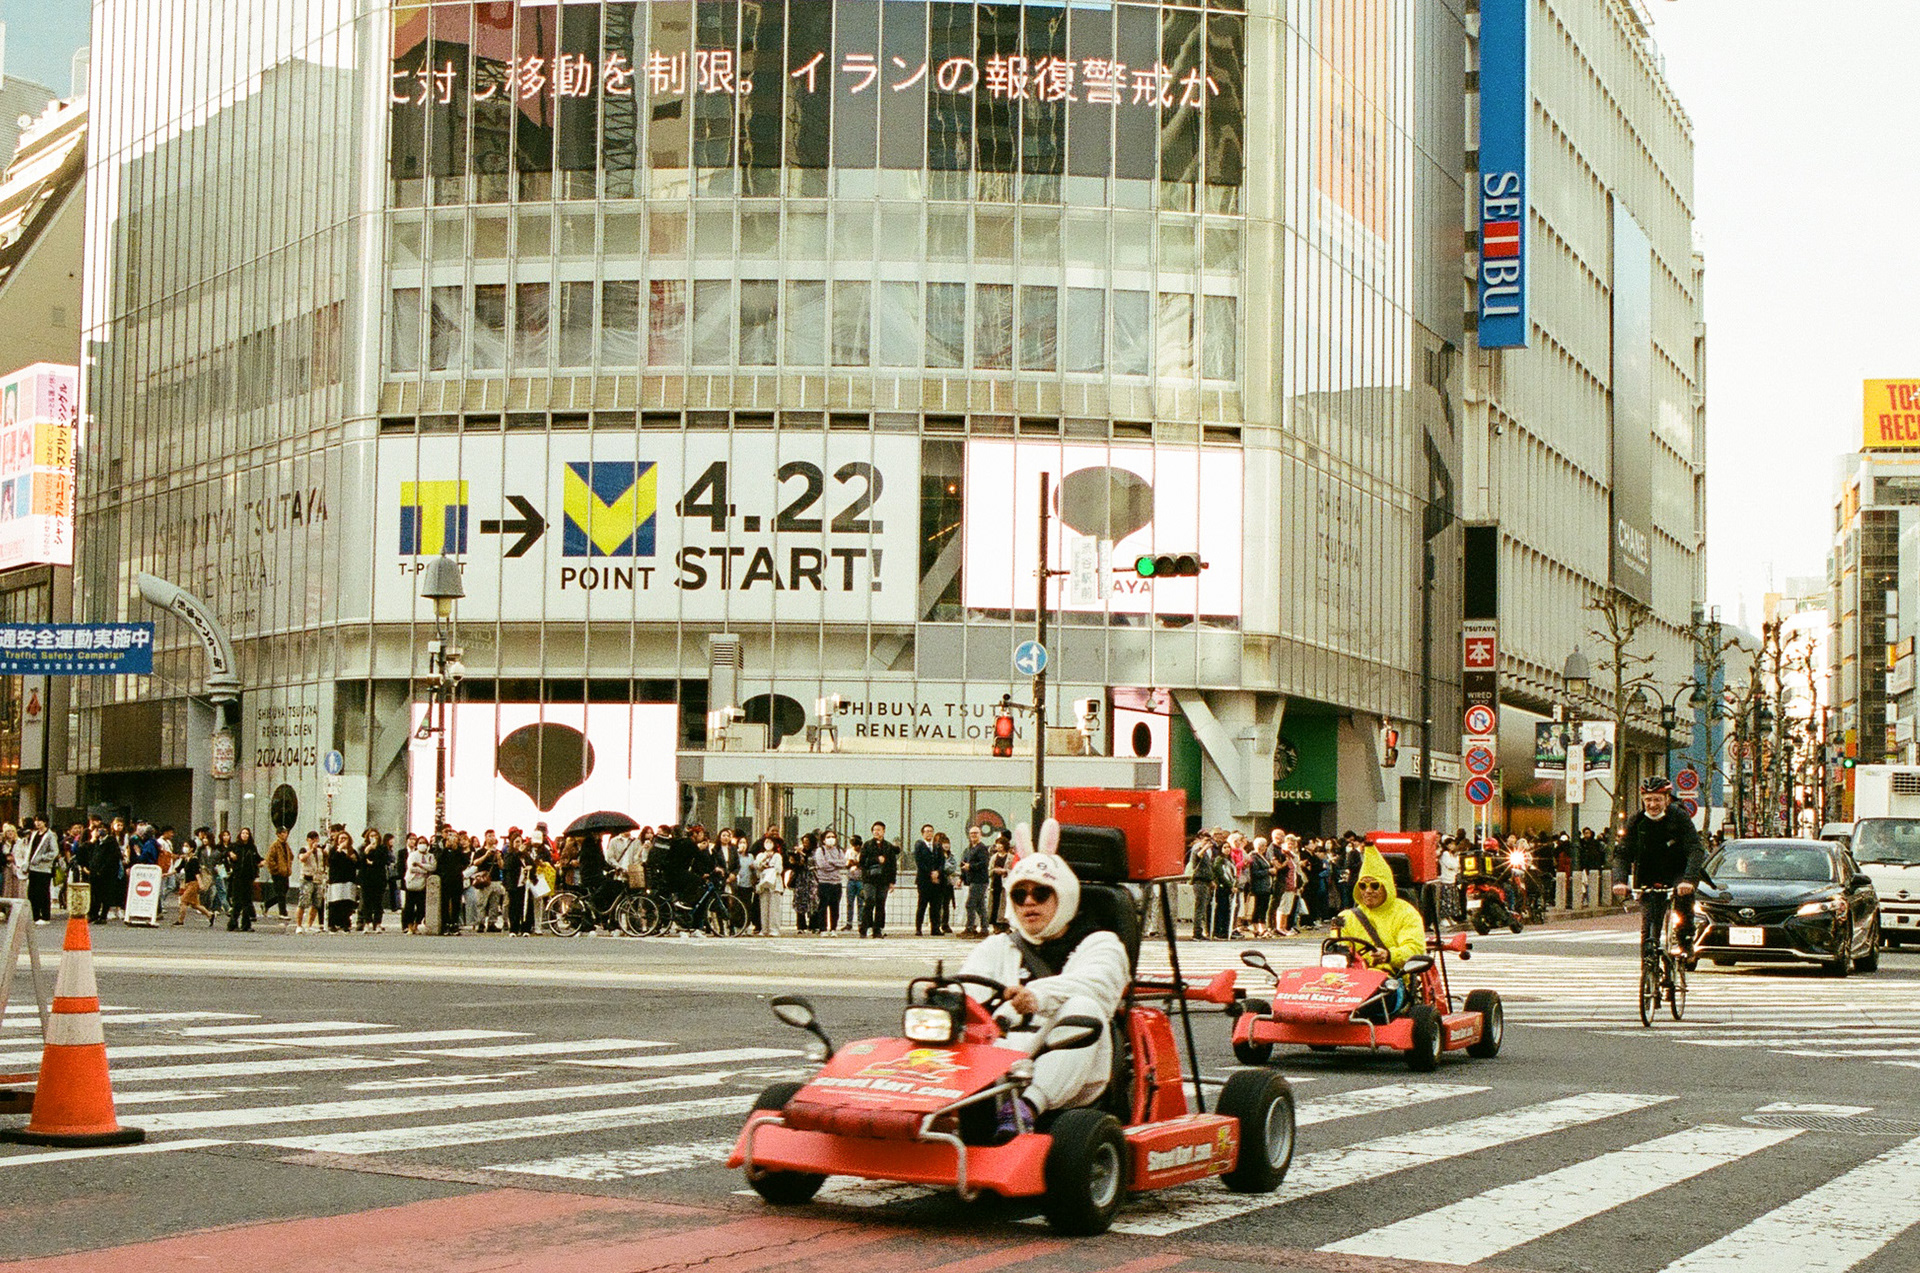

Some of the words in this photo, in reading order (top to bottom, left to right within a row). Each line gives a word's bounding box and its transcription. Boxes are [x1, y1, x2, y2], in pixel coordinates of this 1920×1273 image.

[791, 52, 1219, 108] イランの報復警戒か
[1483, 171, 1520, 320] SEIBU
[1879, 414, 1920, 440] REC
[675, 460, 884, 533] 4.22
[398, 563, 467, 575] T-PT
[561, 567, 655, 590] POINT
[674, 546, 883, 592] START!
[1058, 578, 1152, 594] TAYA
[0, 628, 150, 649] 通安全運動実施中
[5, 651, 37, 659] Traffic
[41, 651, 73, 660] Safety
[77, 651, 125, 661] Campaign
[1468, 640, 1491, 664] 本
[293, 723, 313, 736] OEN
[856, 723, 957, 738] RENEWAL
[967, 726, 1022, 740] OPN
[256, 746, 316, 768] 2024.0425
